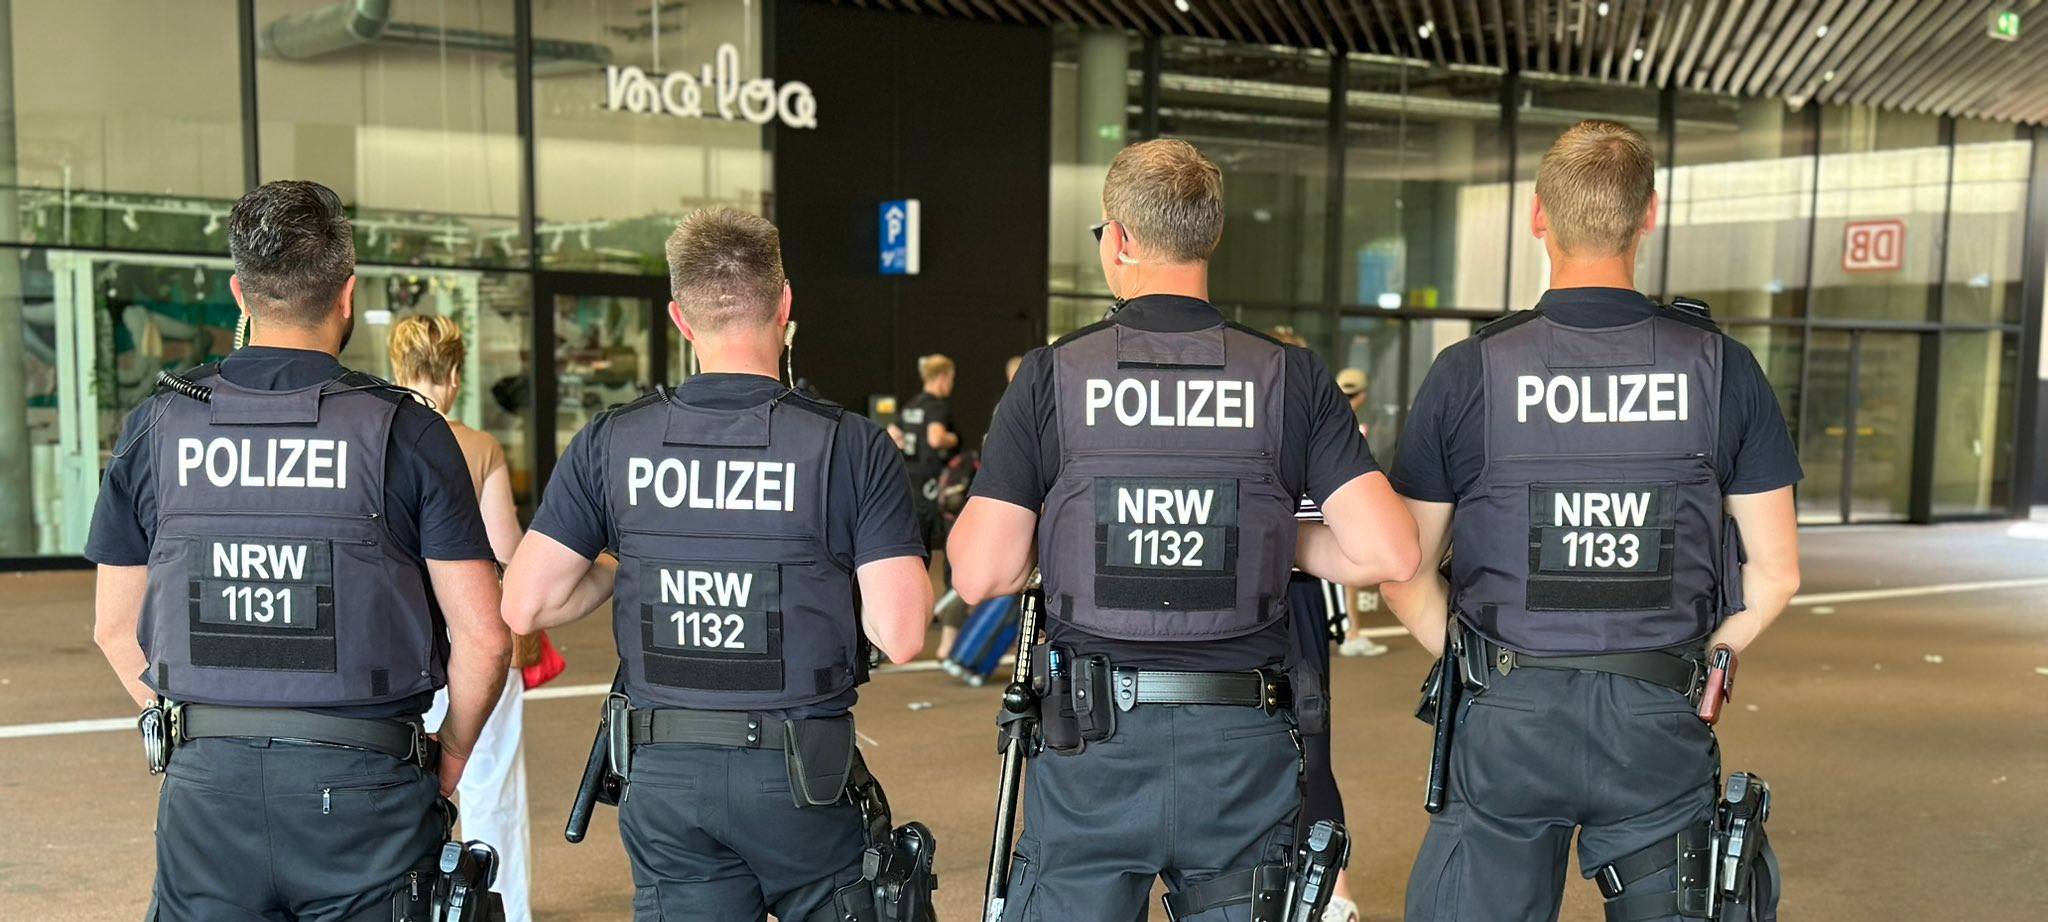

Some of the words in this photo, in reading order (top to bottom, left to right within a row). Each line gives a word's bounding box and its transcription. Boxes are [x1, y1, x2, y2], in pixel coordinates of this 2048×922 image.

[607, 43, 817, 129] ma'loa
[888, 220, 902, 244] P
[1085, 378, 1256, 430] POLIZEI
[1516, 373, 1690, 424] POLIZEI
[177, 437, 349, 490] POLIZEI
[627, 457, 797, 512] POLIZEI
[1117, 486, 1216, 525] NRW
[1554, 491, 1651, 527] NRW
[212, 541, 308, 580] NRW
[1127, 529, 1204, 567] 1132
[1562, 531, 1640, 569] 1133
[221, 586, 292, 624] 1131
[660, 568, 753, 608] NRW
[670, 611, 745, 649] 1132
